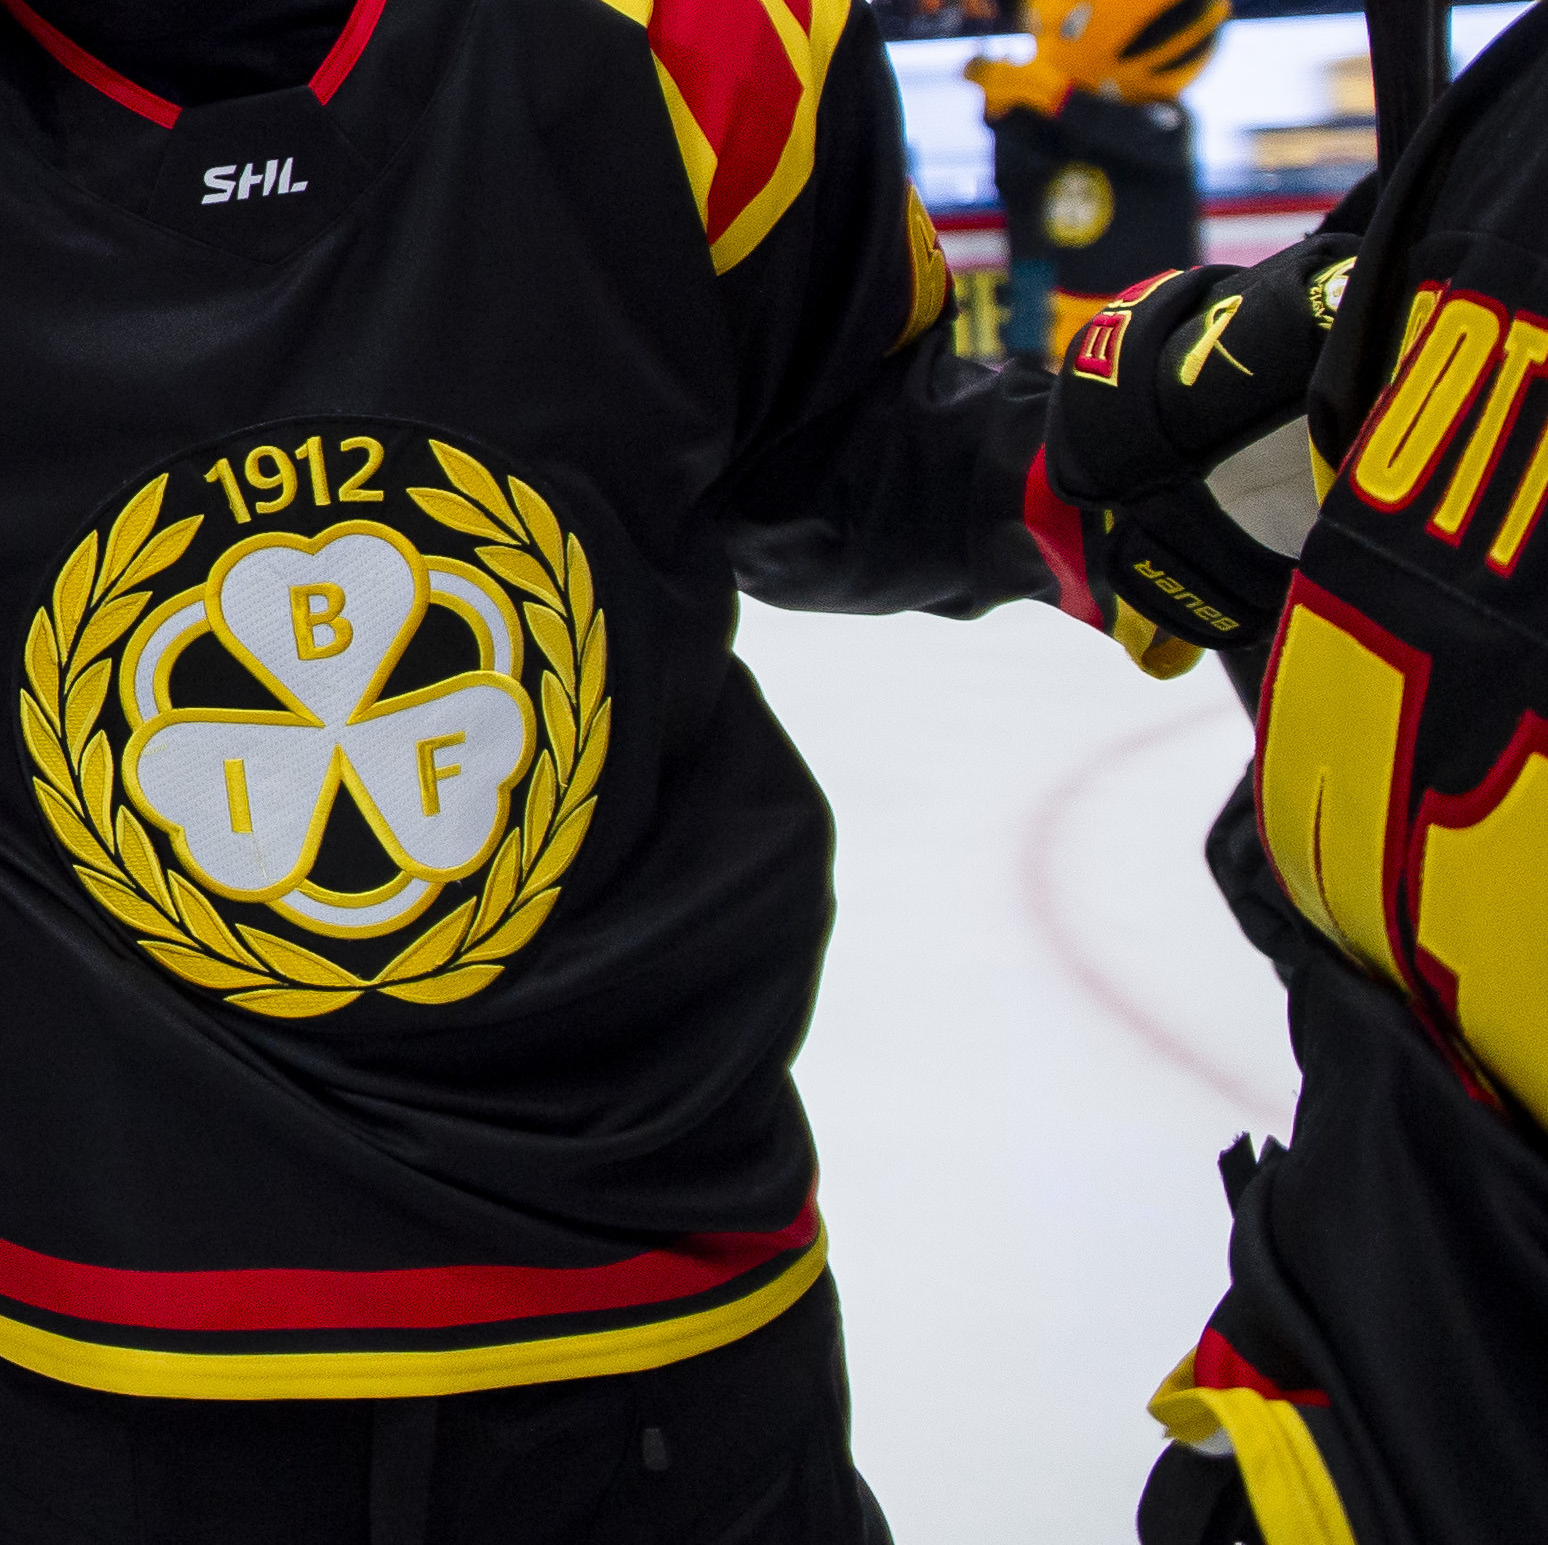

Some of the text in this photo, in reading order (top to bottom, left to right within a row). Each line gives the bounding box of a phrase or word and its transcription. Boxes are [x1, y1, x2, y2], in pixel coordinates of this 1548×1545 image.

[201, 157, 308, 205] SHL
[204, 435, 386, 524] 1912
[288, 581, 354, 661] B
[415, 730, 467, 818] F
